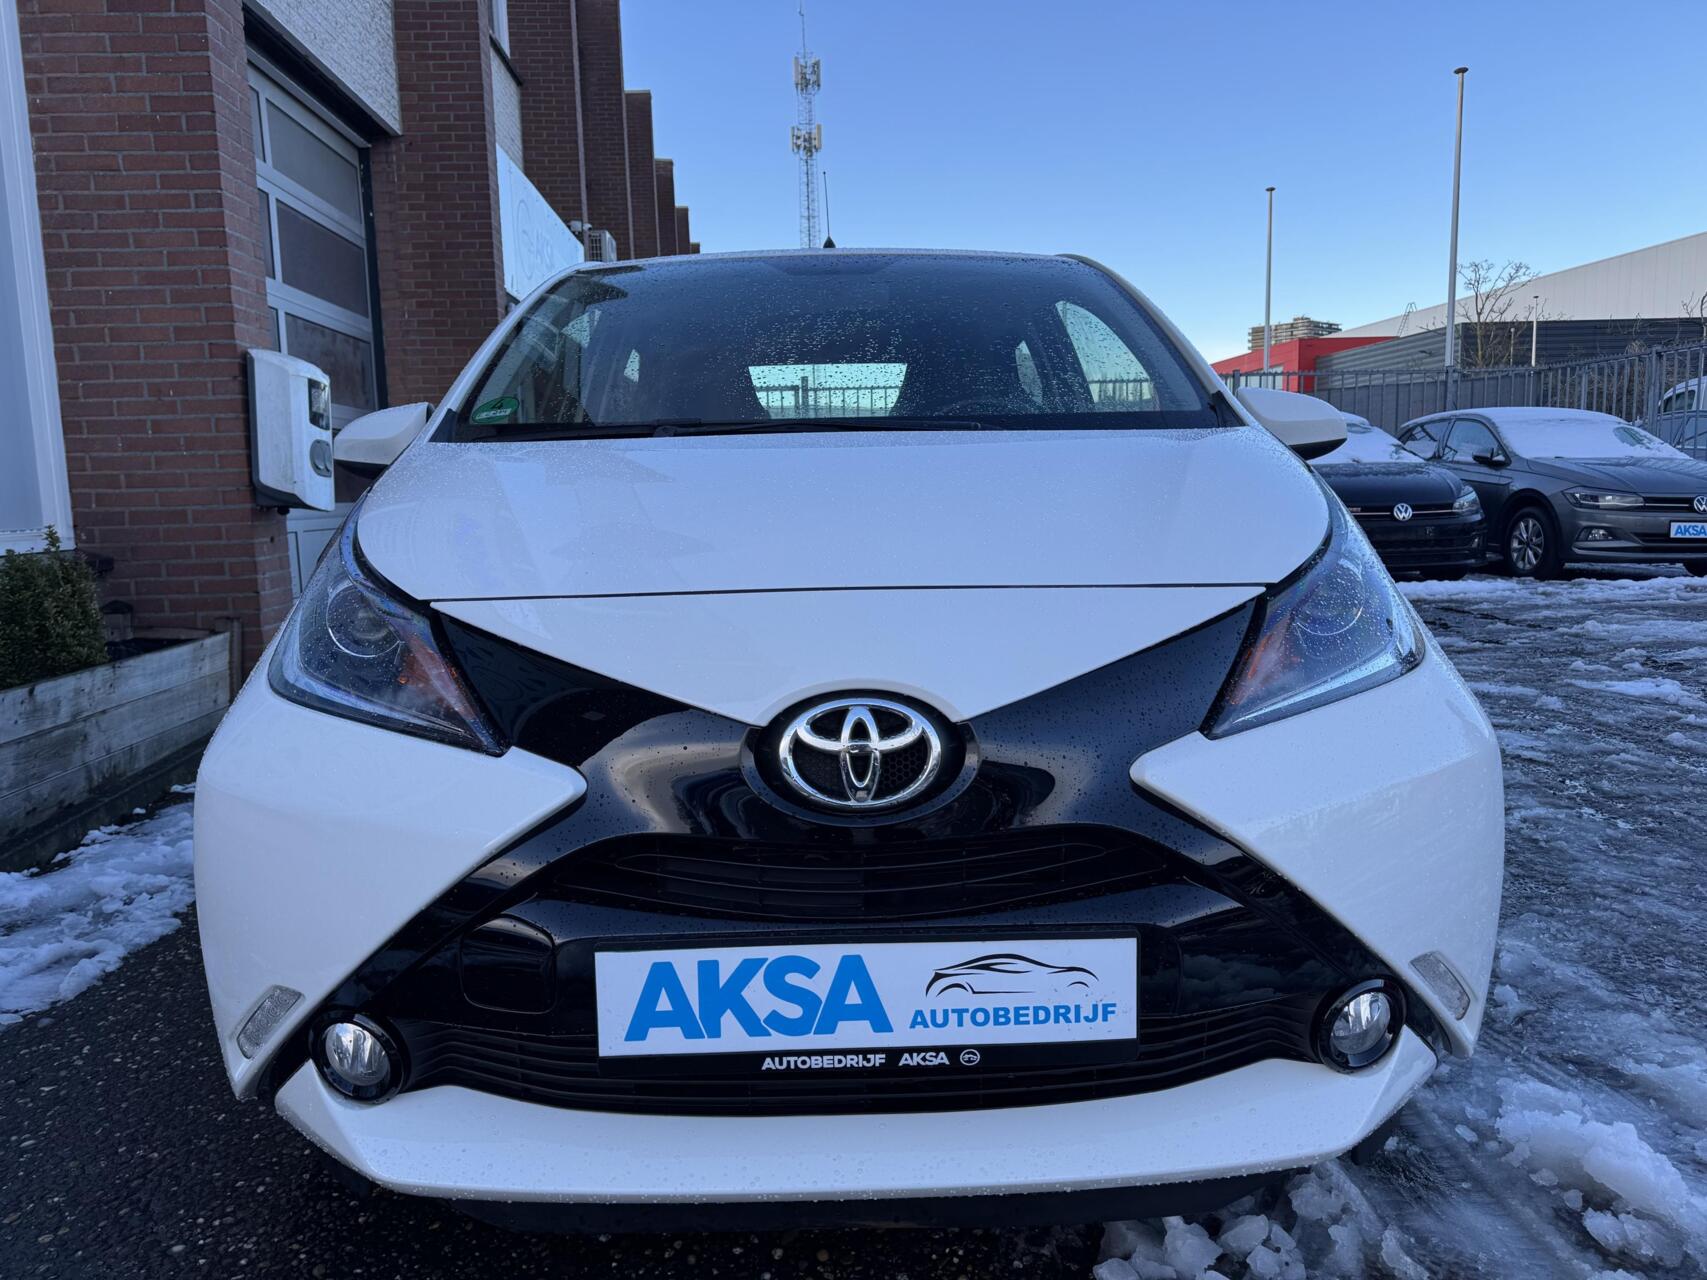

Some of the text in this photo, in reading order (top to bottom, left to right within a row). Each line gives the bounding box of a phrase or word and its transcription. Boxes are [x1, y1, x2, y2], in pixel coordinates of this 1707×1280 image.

[1674, 525, 1707, 536] AKSA
[624, 953, 894, 1042] AKSA
[909, 1002, 1117, 1029] AUTOBEDRIJF
[761, 1051, 950, 1070] AUTOBEDRIJF AKSA
